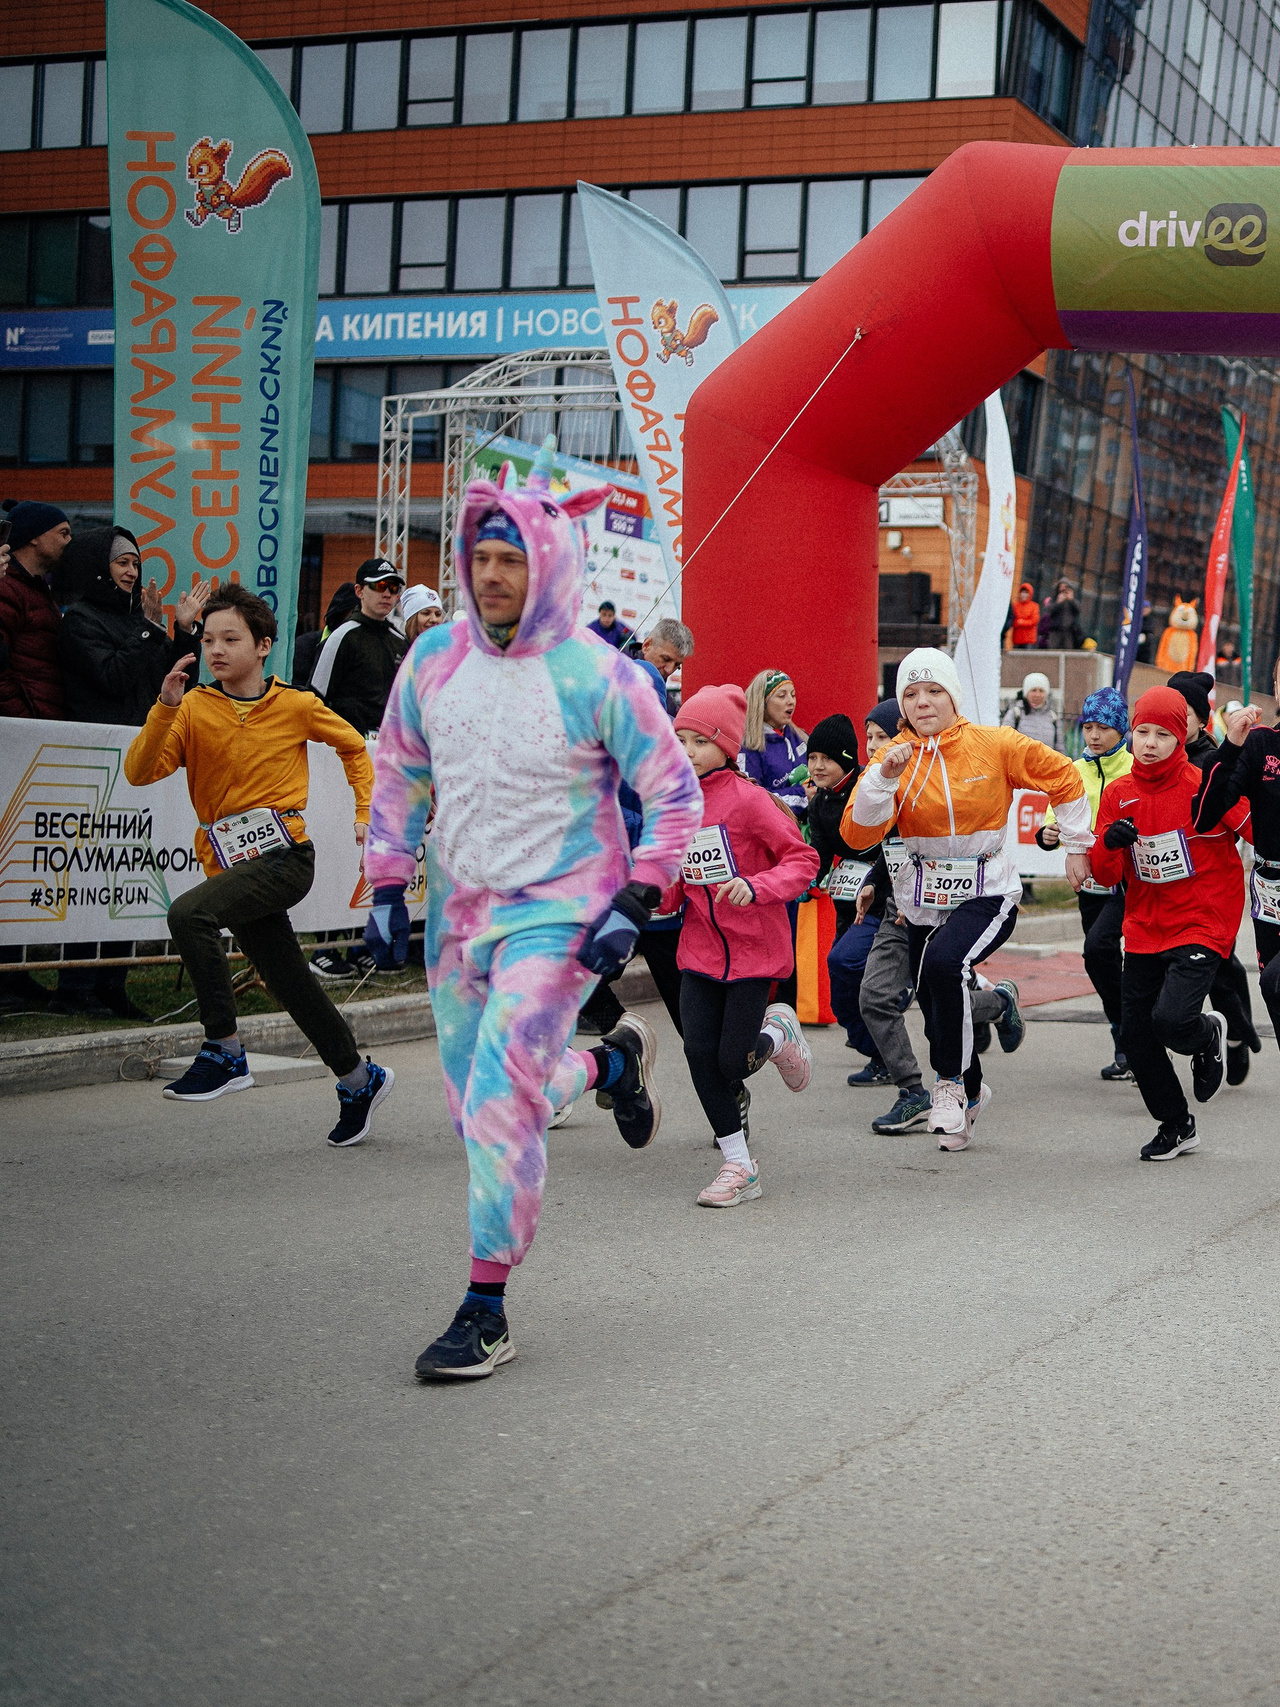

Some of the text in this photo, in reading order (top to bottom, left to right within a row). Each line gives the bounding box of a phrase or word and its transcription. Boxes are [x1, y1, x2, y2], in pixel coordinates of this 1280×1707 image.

[1118, 210, 1267, 254] drivee
[343, 309, 488, 340] КИПЕНИЯ
[34, 807, 153, 840] ВЕСЕННИЙ
[236, 822, 276, 849] 3055
[32, 846, 201, 873] ПОЛУМАРАФОН
[1145, 849, 1180, 866] 3043
[836, 875, 862, 887] 3040
[934, 877, 973, 891] 3070
[29, 886, 149, 907] #SPRINGRUN
